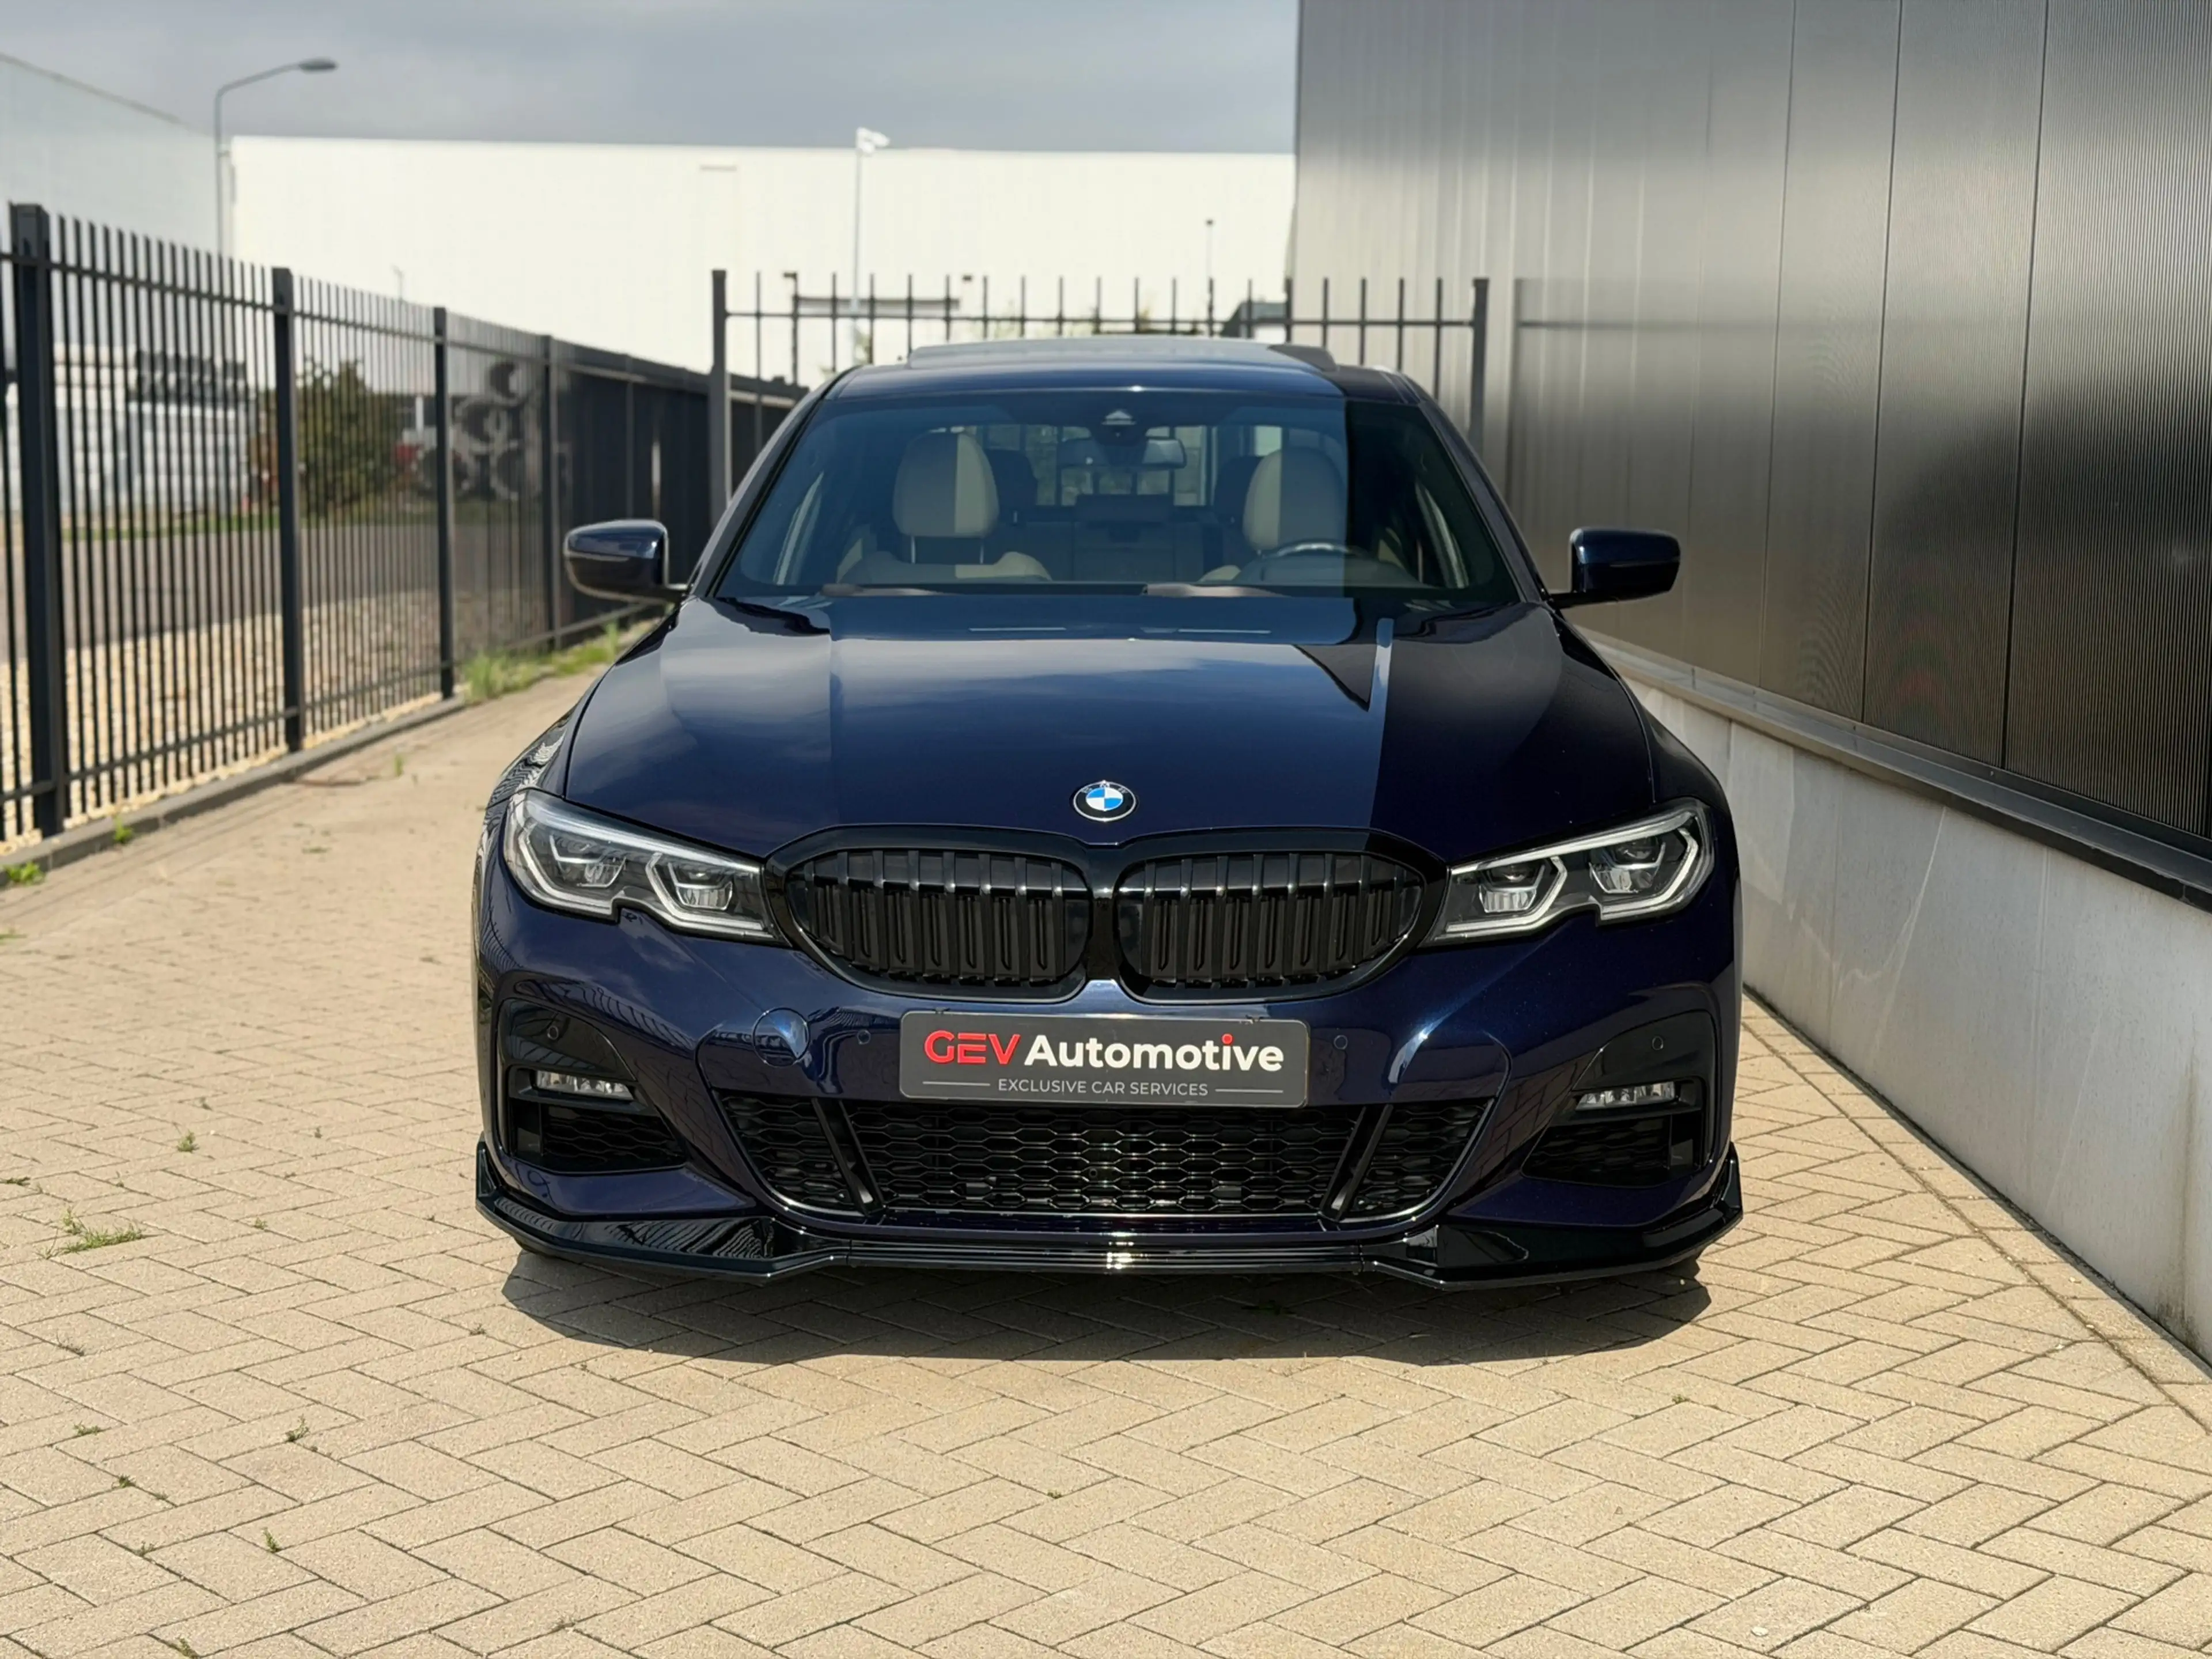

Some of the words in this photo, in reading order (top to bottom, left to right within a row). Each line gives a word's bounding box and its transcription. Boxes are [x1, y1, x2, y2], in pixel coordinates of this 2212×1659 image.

[924, 1030, 1020, 1065] GEV
[1024, 1034, 1284, 1071] Automotive
[998, 1078, 1086, 1094] EXCLUSIVE
[1092, 1081, 1125, 1094] CAR
[1130, 1082, 1209, 1096] SERVICES
